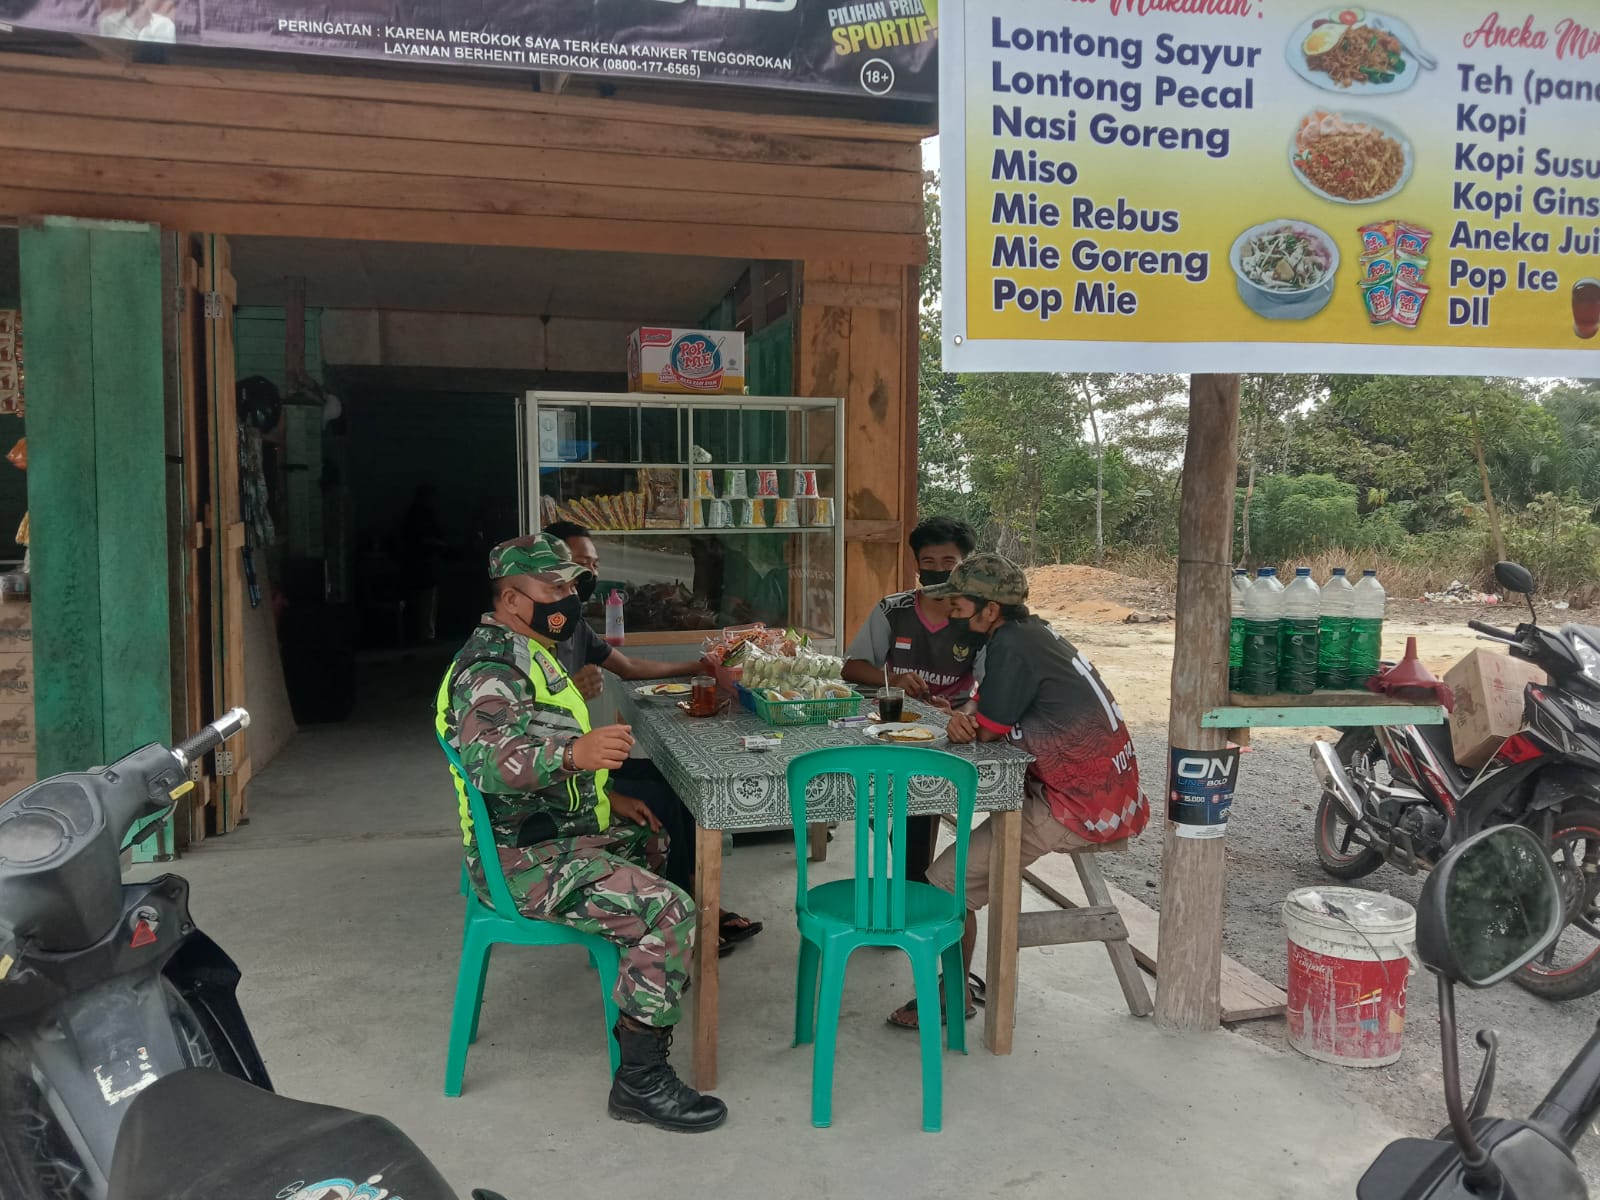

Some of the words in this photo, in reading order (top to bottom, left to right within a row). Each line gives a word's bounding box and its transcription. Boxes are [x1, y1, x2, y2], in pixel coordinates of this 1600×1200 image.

[828, 3, 887, 27] PILIHAN
[890, 0, 924, 16] PRIA
[1463, 12, 1549, 49] Aneka
[278, 19, 371, 37] PERINGATAN
[385, 26, 445, 42] KARENA
[449, 30, 521, 48] MEROKOK
[525, 36, 560, 51] SAYA
[562, 38, 628, 56] TERKENA
[631, 44, 688, 61] KANKER
[692, 49, 792, 71] TENGGOROKAN
[384, 42, 450, 58] LAYANAN
[454, 46, 526, 63] BERHENTI
[529, 51, 600, 69] MEROKOK
[602, 57, 701, 78] (0800-177-6565)
[992, 17, 1143, 69] Lontong
[1155, 33, 1262, 74] Sayur
[865, 70, 889, 84] 18+
[992, 61, 1142, 112] Lontong
[1155, 76, 1254, 109] Pecal
[1457, 63, 1513, 95] Teh
[992, 105, 1077, 141] Nasi
[1089, 113, 1230, 158] Goreng
[1456, 103, 1527, 142] Kopi
[991, 149, 1078, 185] Miso
[1455, 143, 1524, 180] Kopi
[1534, 149, 1600, 180] Susu
[991, 193, 1060, 227] Mie
[1072, 198, 1179, 233] Rebus
[1453, 182, 1522, 219] Kopi
[1450, 221, 1549, 253] Aneka
[991, 236, 1060, 270] Mie
[1072, 240, 1209, 282] Goreng
[1450, 260, 1506, 296] Pop
[1518, 263, 1558, 291] Ice
[994, 280, 1062, 320] Pop
[1074, 282, 1137, 314] Mie
[1449, 298, 1489, 326] Dll
[680, 342, 705, 357] POP
[684, 354, 712, 369] MIE
[1177, 756, 1234, 779] ON
[1206, 778, 1228, 787] BOLD
